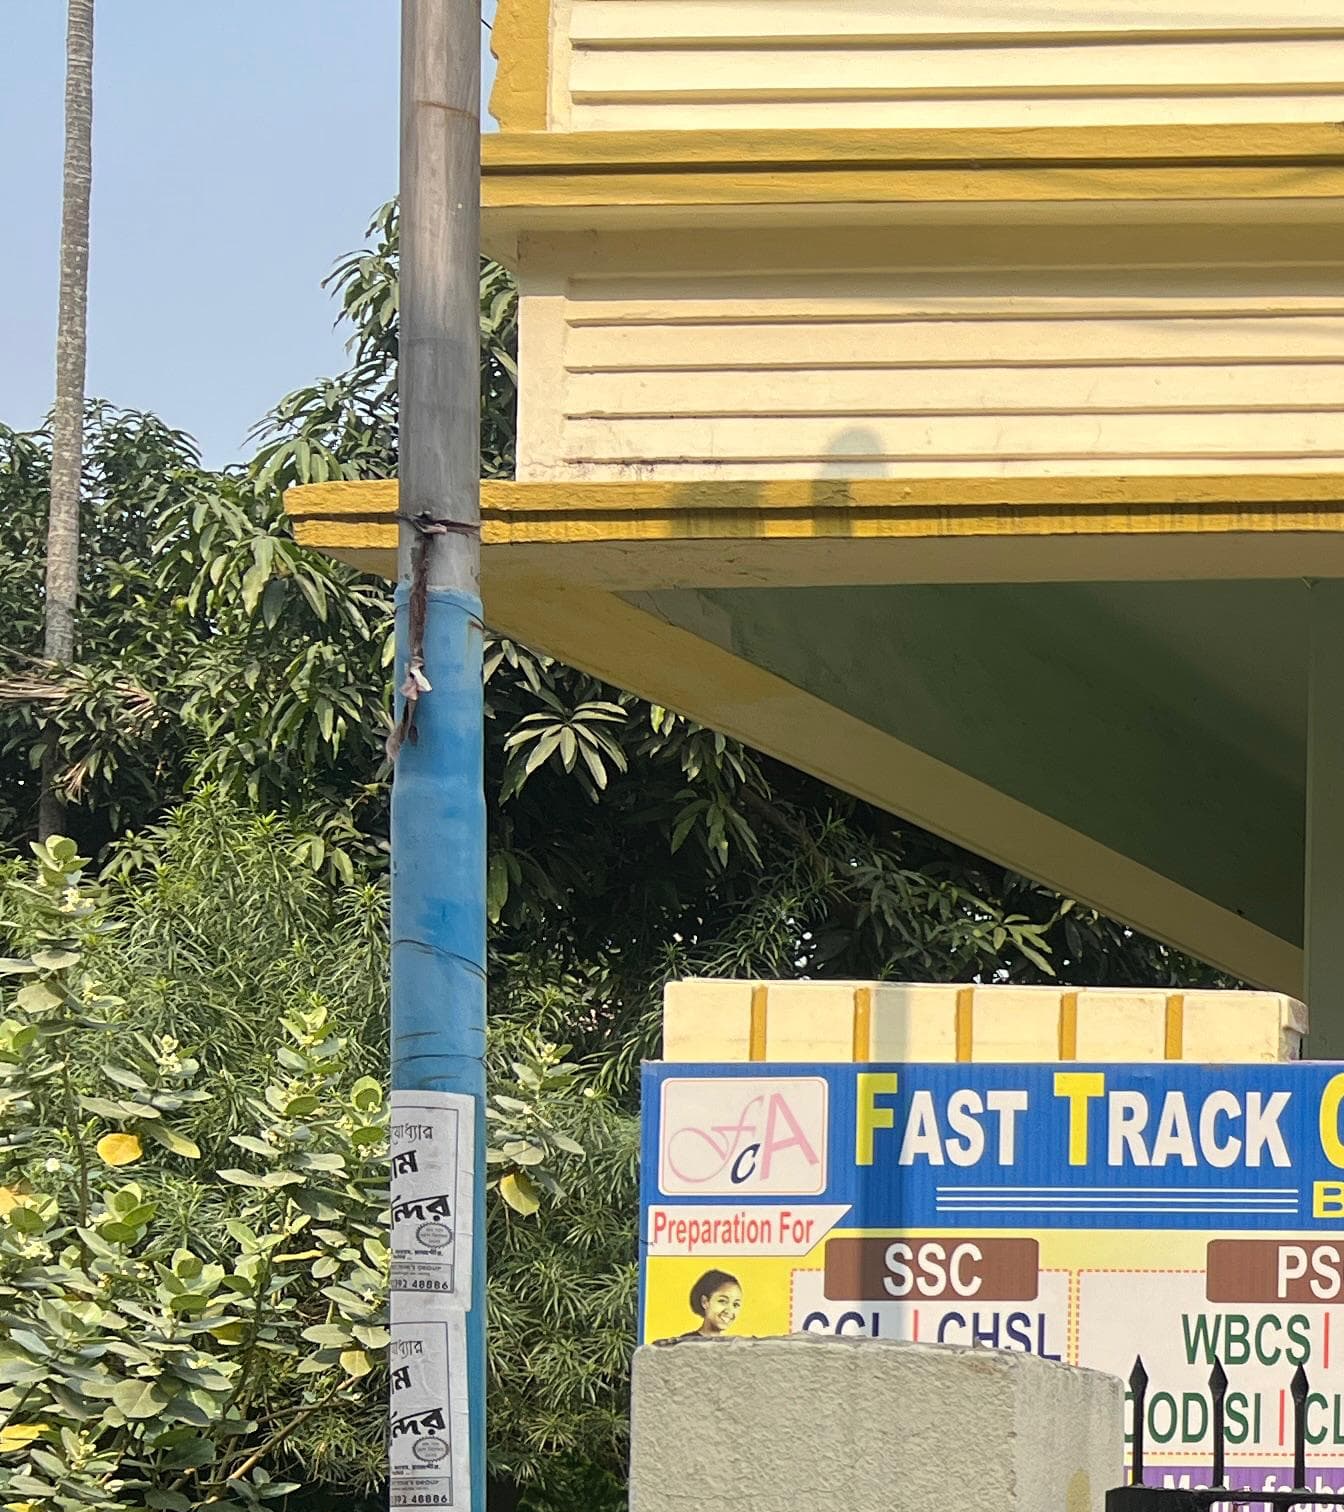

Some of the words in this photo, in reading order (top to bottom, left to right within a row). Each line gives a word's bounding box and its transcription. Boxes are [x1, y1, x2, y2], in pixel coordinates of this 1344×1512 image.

[855, 1073, 1028, 1166] FAST
[1053, 1072, 1292, 1168] TRACK
[654, 1211, 772, 1252] Preparation
[779, 1211, 814, 1244] For
[882, 1242, 983, 1297] SSC
[1181, 1313, 1311, 1366] WBCS
[1222, 1391, 1261, 1444] SI
